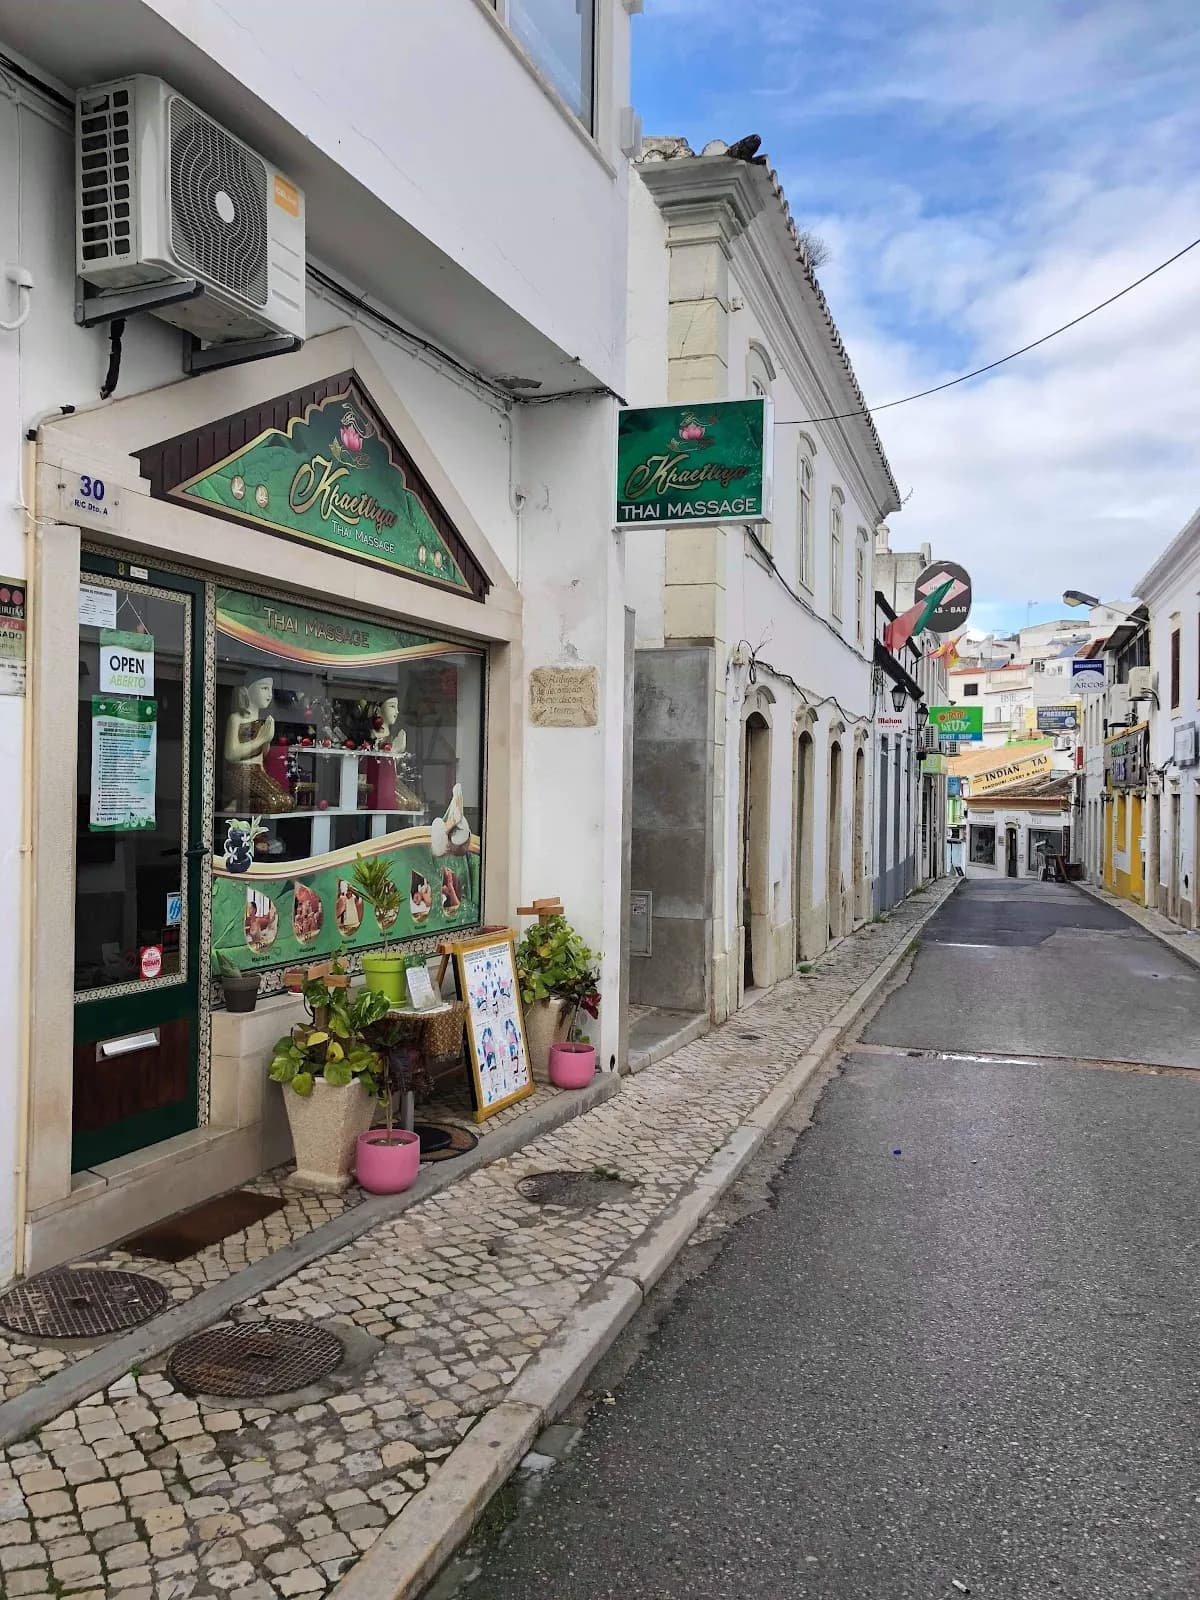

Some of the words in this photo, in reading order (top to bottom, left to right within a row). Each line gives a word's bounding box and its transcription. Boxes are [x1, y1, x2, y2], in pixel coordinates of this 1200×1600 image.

[80, 475, 105, 501] 30
[103, 507, 108, 515] A
[620, 503, 660, 519] THAI
[667, 497, 757, 517] MASSAGE
[331, 520, 351, 537] THAI
[355, 530, 396, 553] MASSAGE
[263, 606, 299, 633] THAI
[304, 615, 370, 649] MASSAGE
[109, 655, 145, 675] OPEN
[110, 674, 147, 689] ABERTO
[1073, 681, 1105, 690] ARCOS
[984, 765, 1020, 782] INDIAN
[1031, 756, 1048, 767] TAJ
